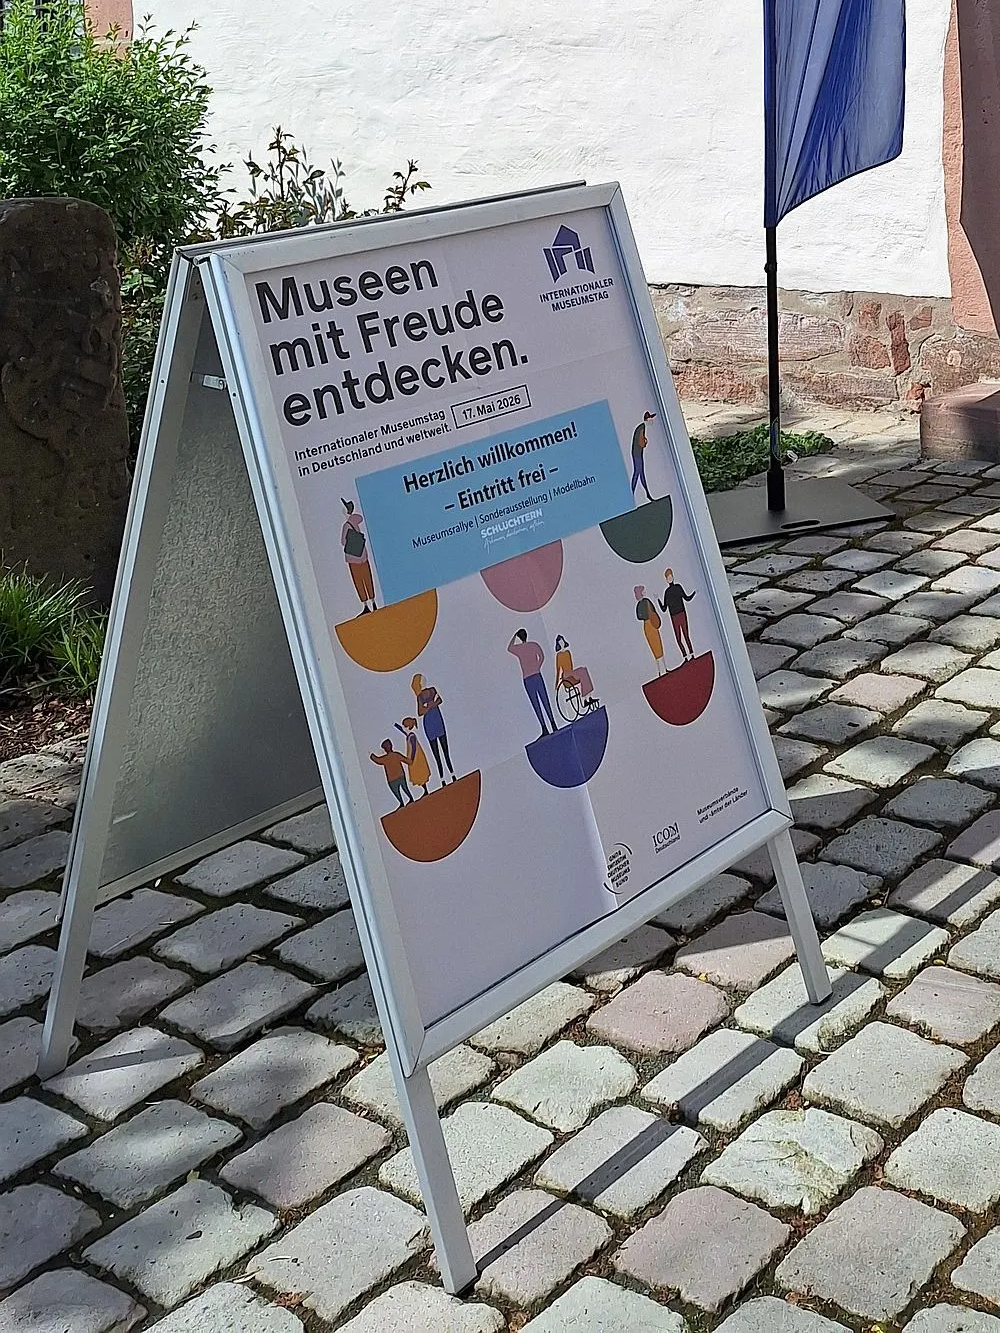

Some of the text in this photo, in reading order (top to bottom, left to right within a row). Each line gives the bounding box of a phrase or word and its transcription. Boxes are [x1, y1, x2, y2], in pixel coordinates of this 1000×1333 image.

[255, 259, 438, 324] Museen
[539, 277, 614, 303] INTERNATIONALER
[551, 290, 609, 312] MUSEUMSTAG
[269, 289, 504, 376] mit Freude
[283, 339, 528, 426] entdecken.
[462, 394, 521, 421] 17. Mai 2026
[294, 409, 446, 462] Internationaler Museumstag
[298, 423, 452, 477] in Deutschland und weltweit.
[402, 421, 578, 494] Herzlich willkommen!
[412, 520, 474, 549] Museumsrallye
[479, 491, 548, 525] Sonderausstellung
[553, 475, 596, 498] Modellbahn
[457, 477, 516, 510] Eintritt
[518, 463, 547, 488] frei
[652, 821, 679, 847] ICOM
[655, 834, 681, 854] Deutschland
